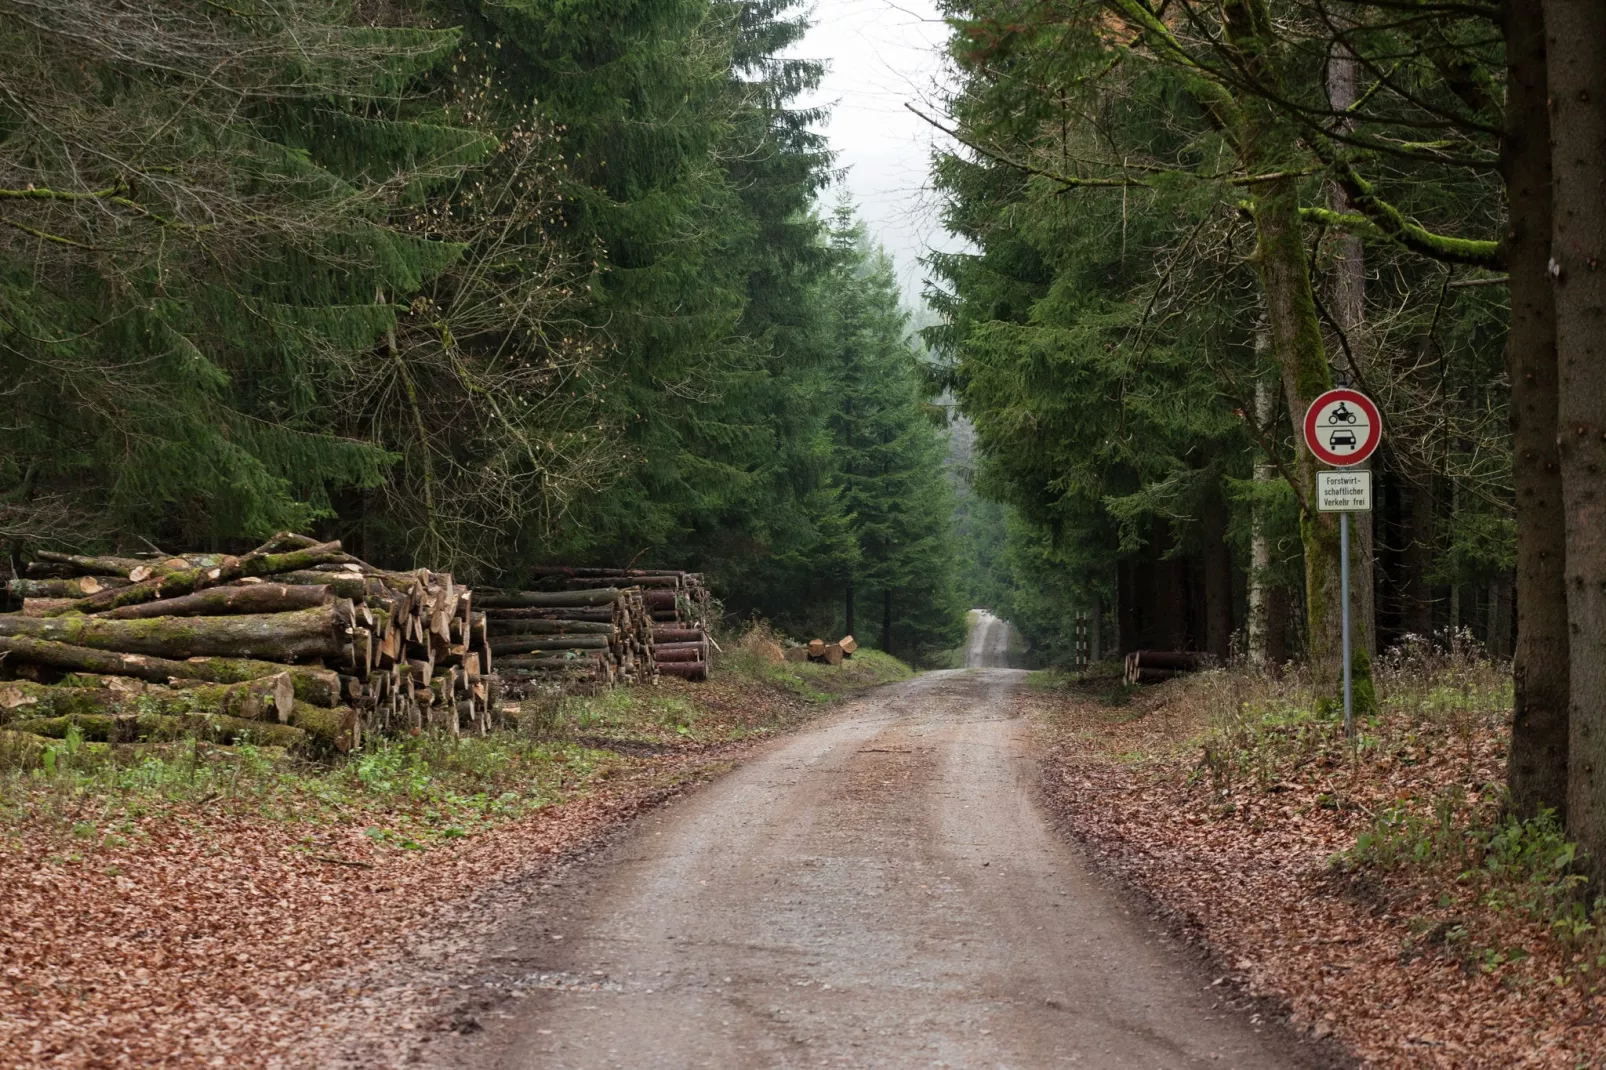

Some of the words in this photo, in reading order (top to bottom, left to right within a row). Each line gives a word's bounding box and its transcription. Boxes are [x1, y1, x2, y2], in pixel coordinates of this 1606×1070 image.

[1326, 476, 1360, 484] Forstwirt-
[1324, 488, 1364, 496] schaftlicher
[1324, 498, 1350, 506] Verkehr
[1354, 498, 1364, 506] frei
